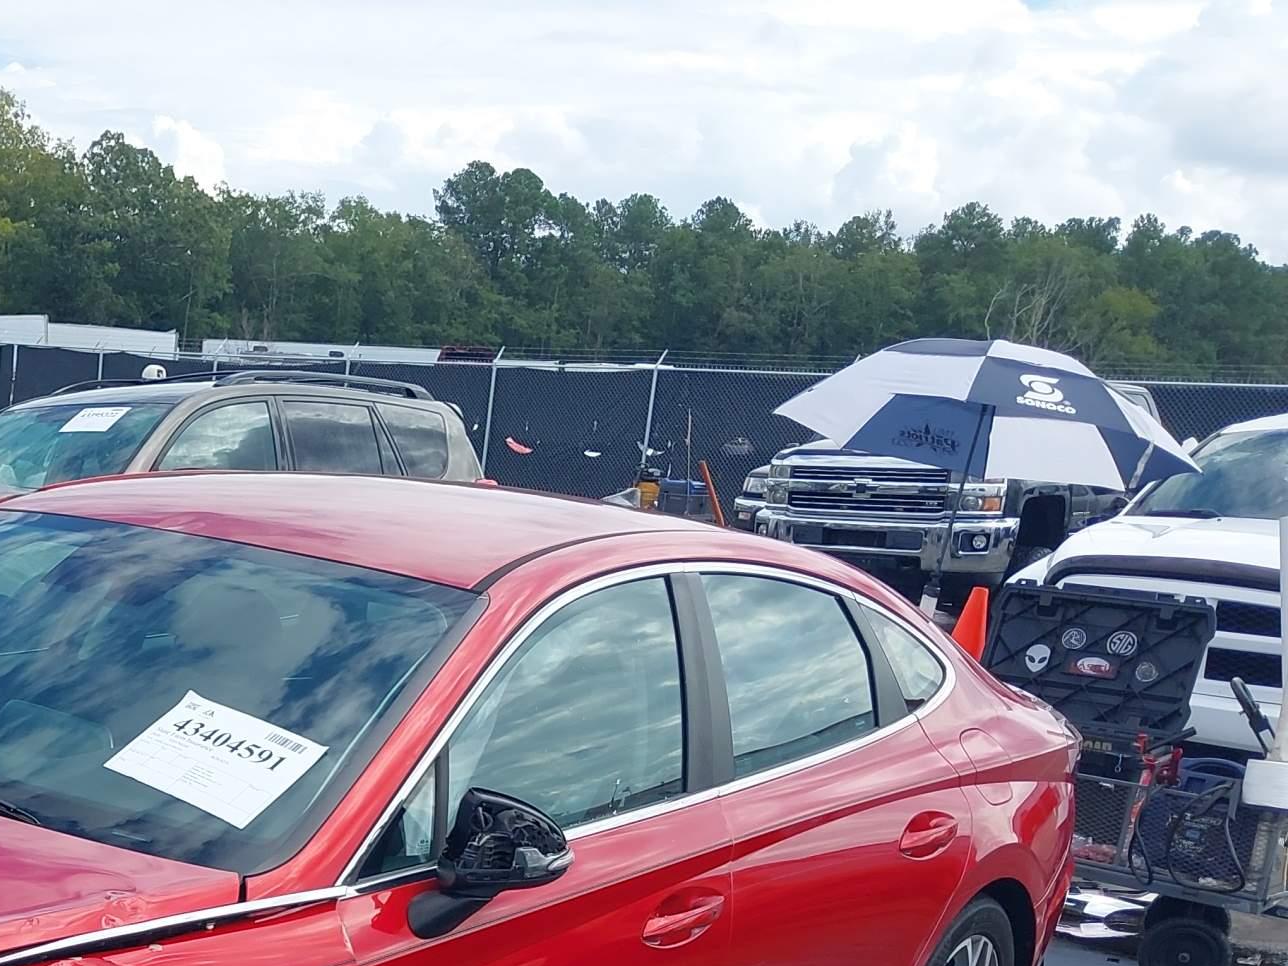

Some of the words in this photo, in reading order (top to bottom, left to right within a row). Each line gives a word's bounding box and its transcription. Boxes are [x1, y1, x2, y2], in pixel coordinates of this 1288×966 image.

[1016, 395, 1077, 415] SONOCO
[1111, 632, 1134, 655] SIG
[173, 719, 287, 771] 43404591
